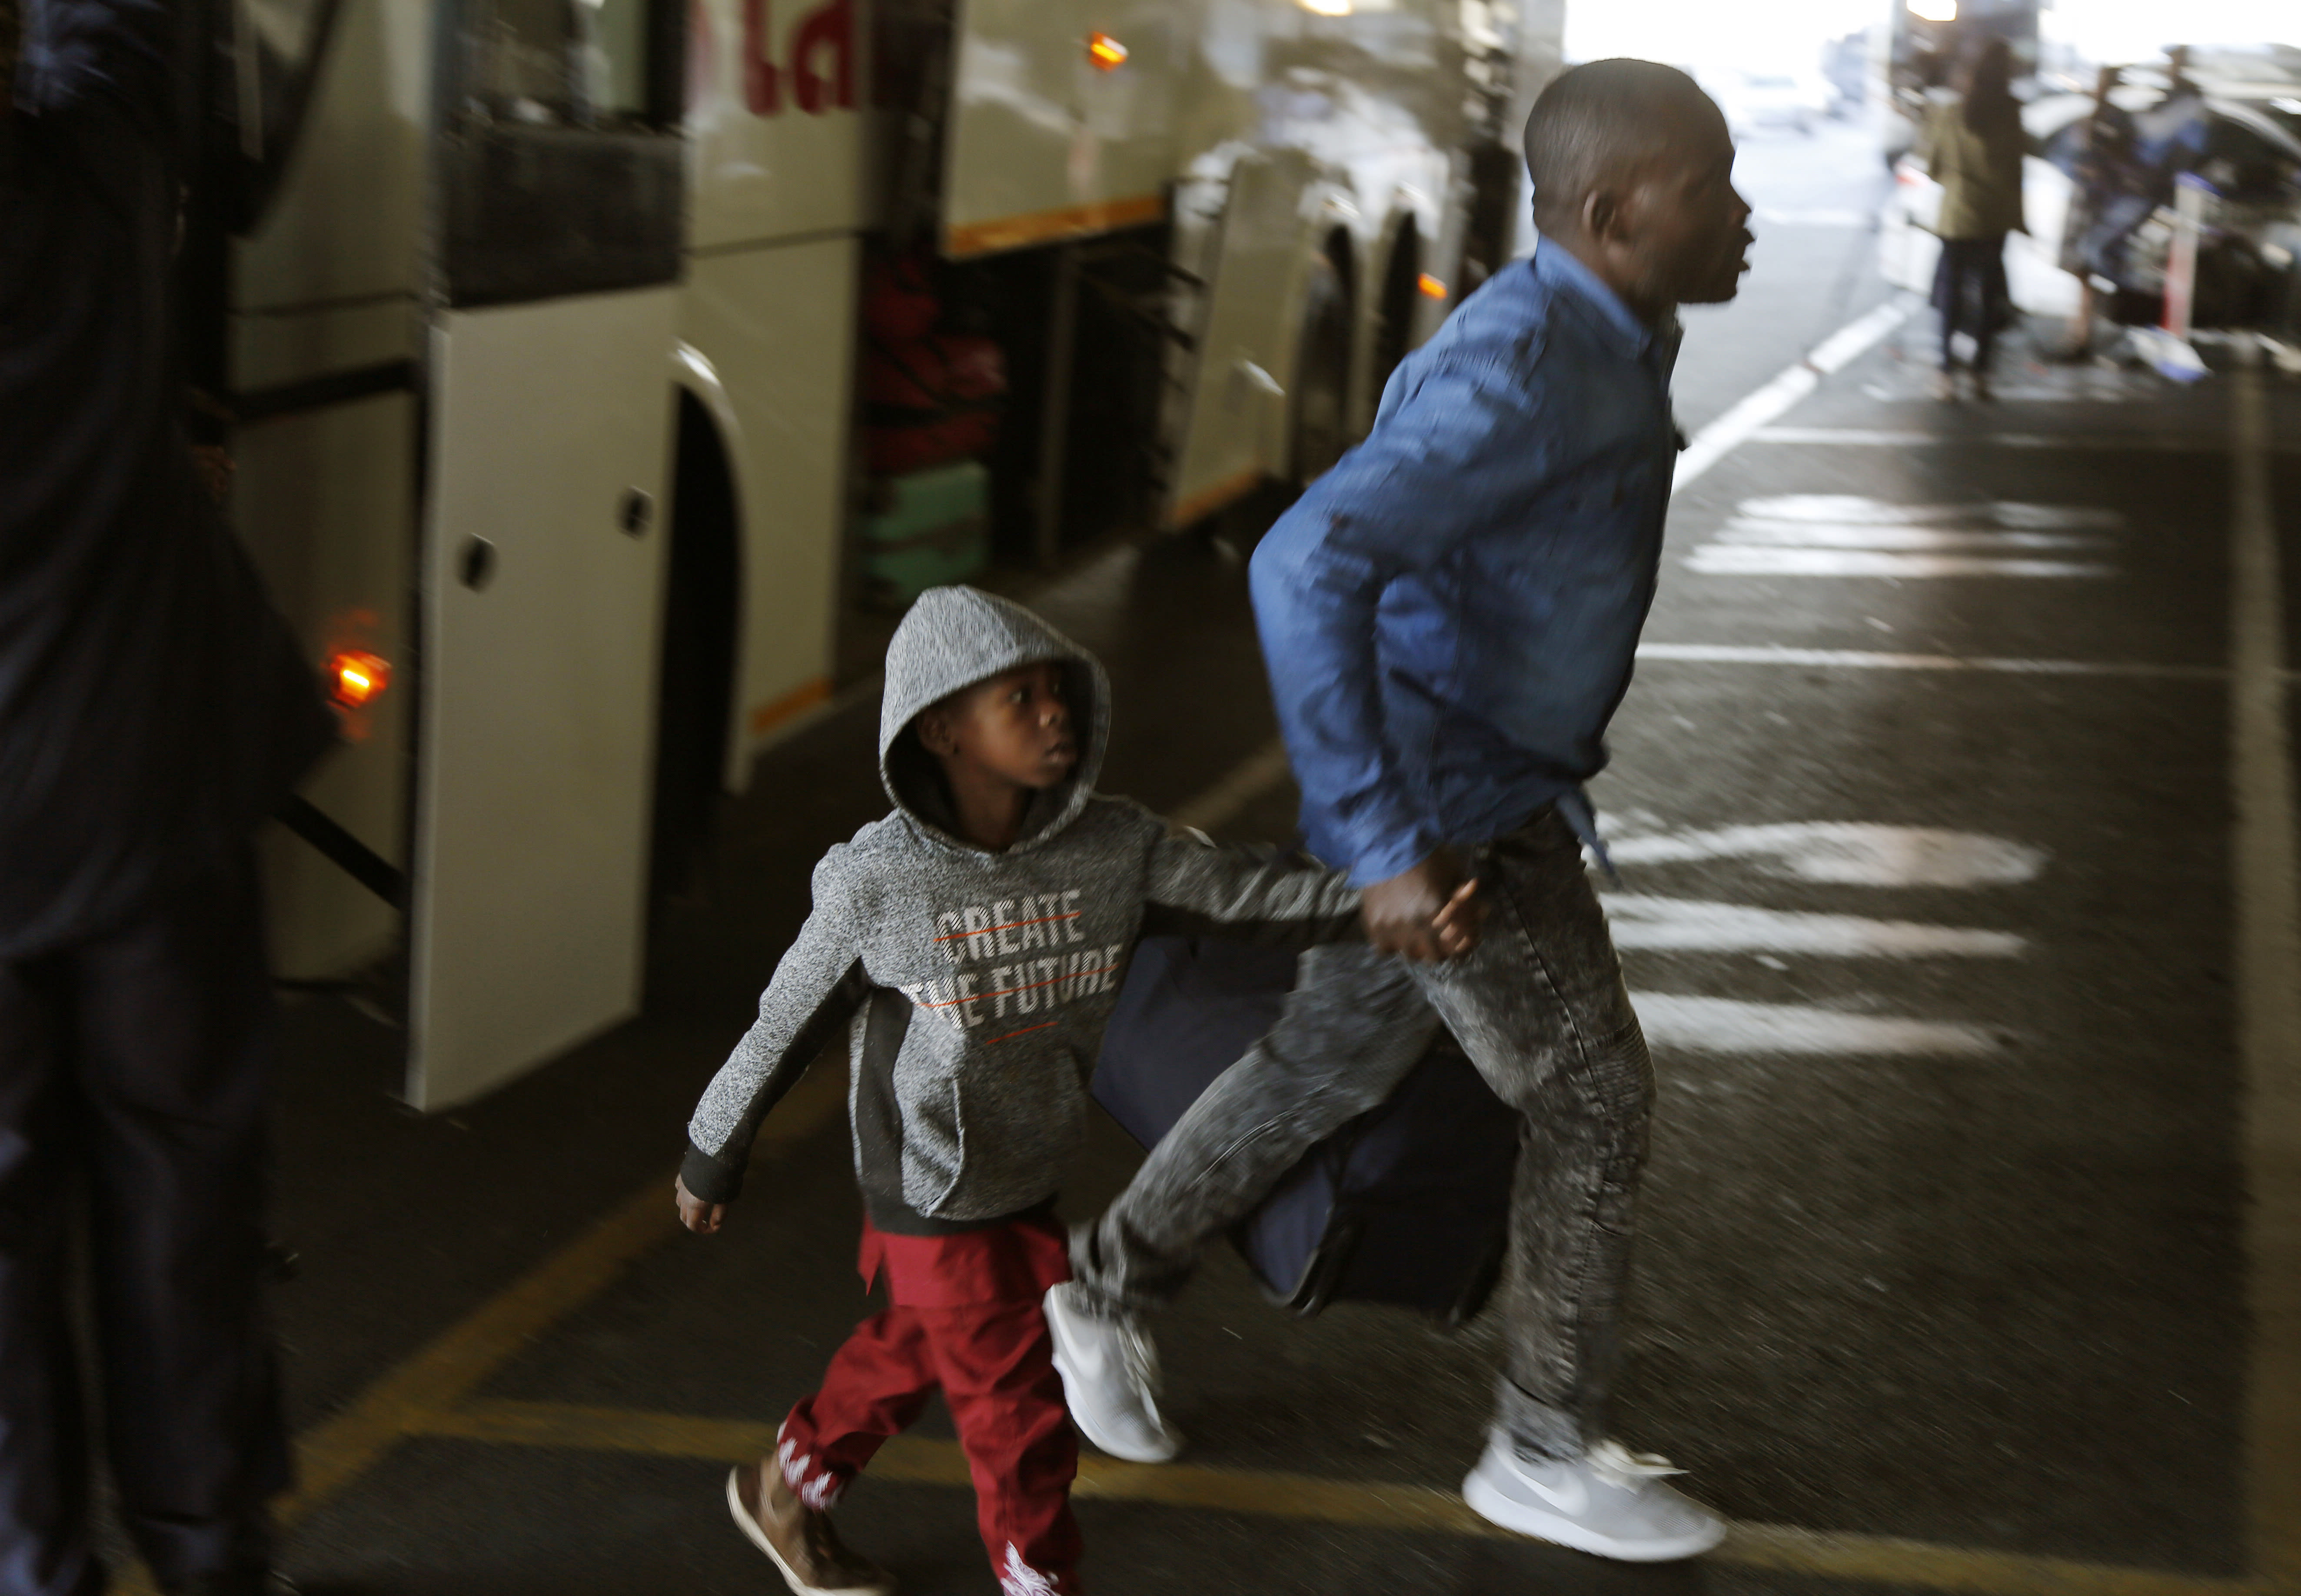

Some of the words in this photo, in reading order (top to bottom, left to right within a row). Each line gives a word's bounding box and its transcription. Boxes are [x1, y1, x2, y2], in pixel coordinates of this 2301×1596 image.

[936, 889, 1085, 965] CREATE
[898, 973, 985, 1030] THE
[991, 944, 1123, 1019] FUTURE
